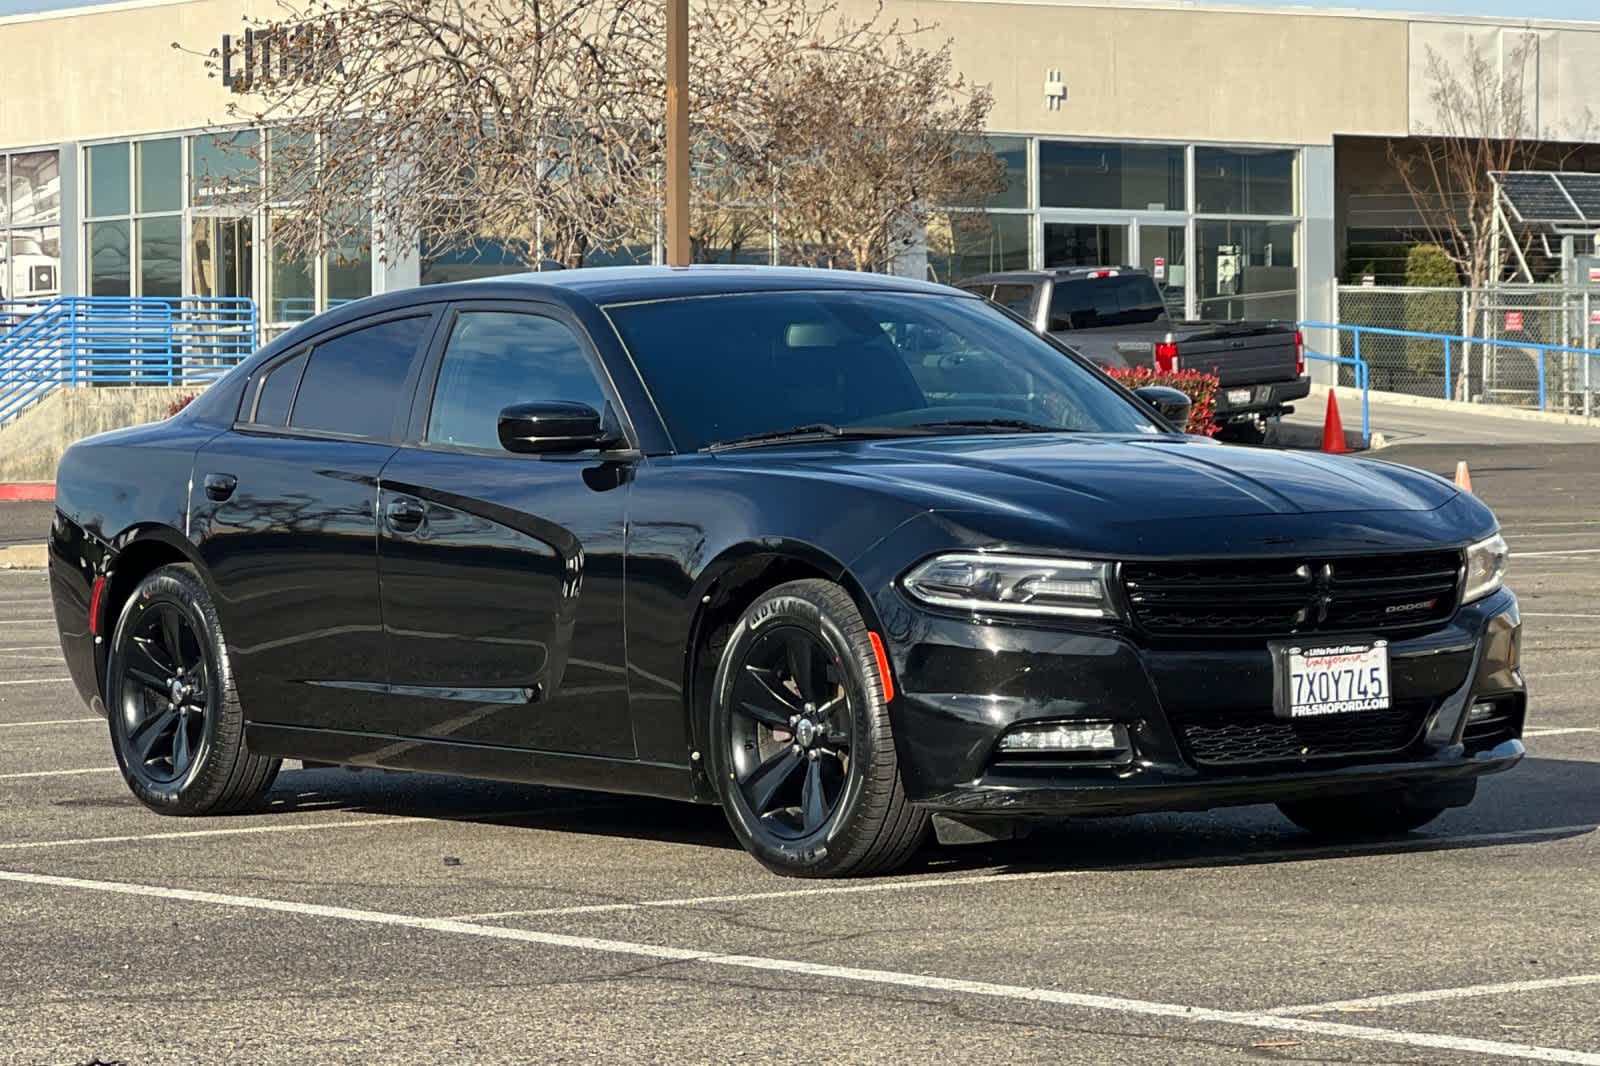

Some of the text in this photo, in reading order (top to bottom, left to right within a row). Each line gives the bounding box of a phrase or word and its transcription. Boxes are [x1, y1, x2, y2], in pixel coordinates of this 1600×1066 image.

[1385, 601, 1432, 613] DODGE
[1305, 654, 1366, 669] California
[1291, 698, 1389, 717] FRESNOFORD.COM
